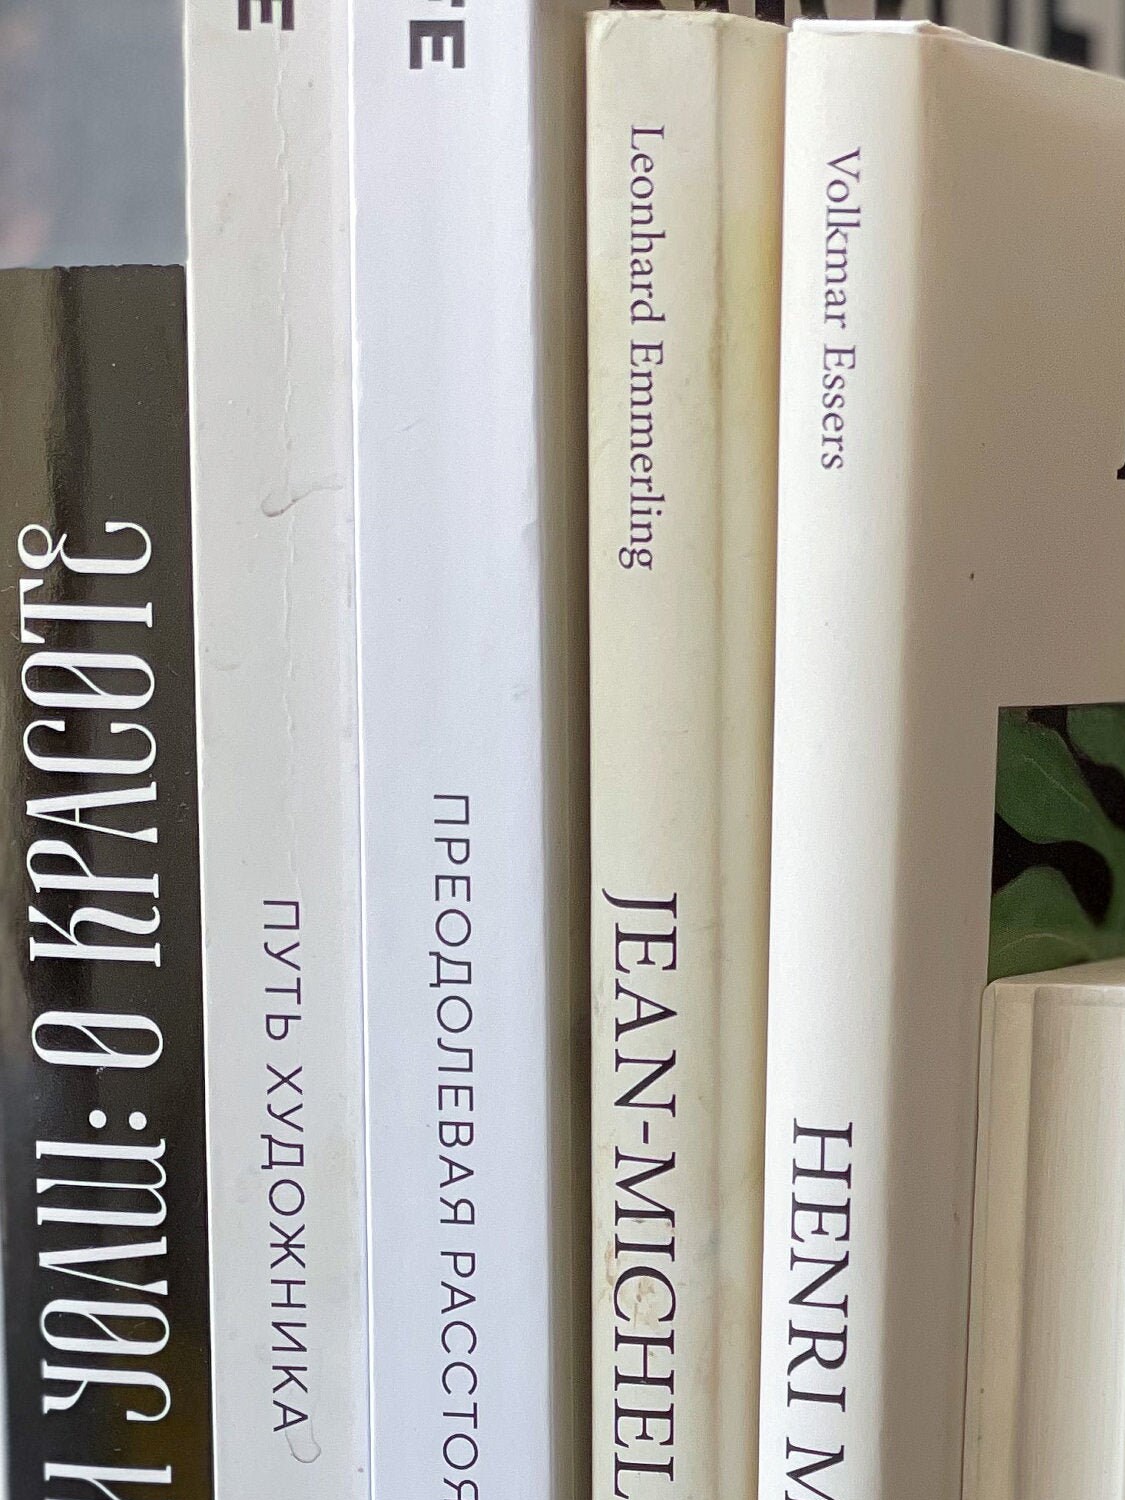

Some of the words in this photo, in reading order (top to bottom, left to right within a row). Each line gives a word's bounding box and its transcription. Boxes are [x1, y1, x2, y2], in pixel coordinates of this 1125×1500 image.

[630, 125, 667, 325] Leonhard
[823, 146, 862, 330] Volkmar
[618, 340, 667, 571] Emmerling
[820, 345, 857, 470] Essers
[17, 520, 162, 968] КРАСОТЕ
[31, 1010, 165, 1069] О
[262, 899, 302, 1042] ПУТЬ
[428, 794, 476, 1225] ПРЕОДОЛЕВАЯ
[35, 1109, 172, 1422] УОЛШ:
[260, 1062, 309, 1433] ХУДОЖНИКА
[601, 887, 678, 1500] JEAN-MICHEL
[786, 1116, 854, 1413] HENRI
